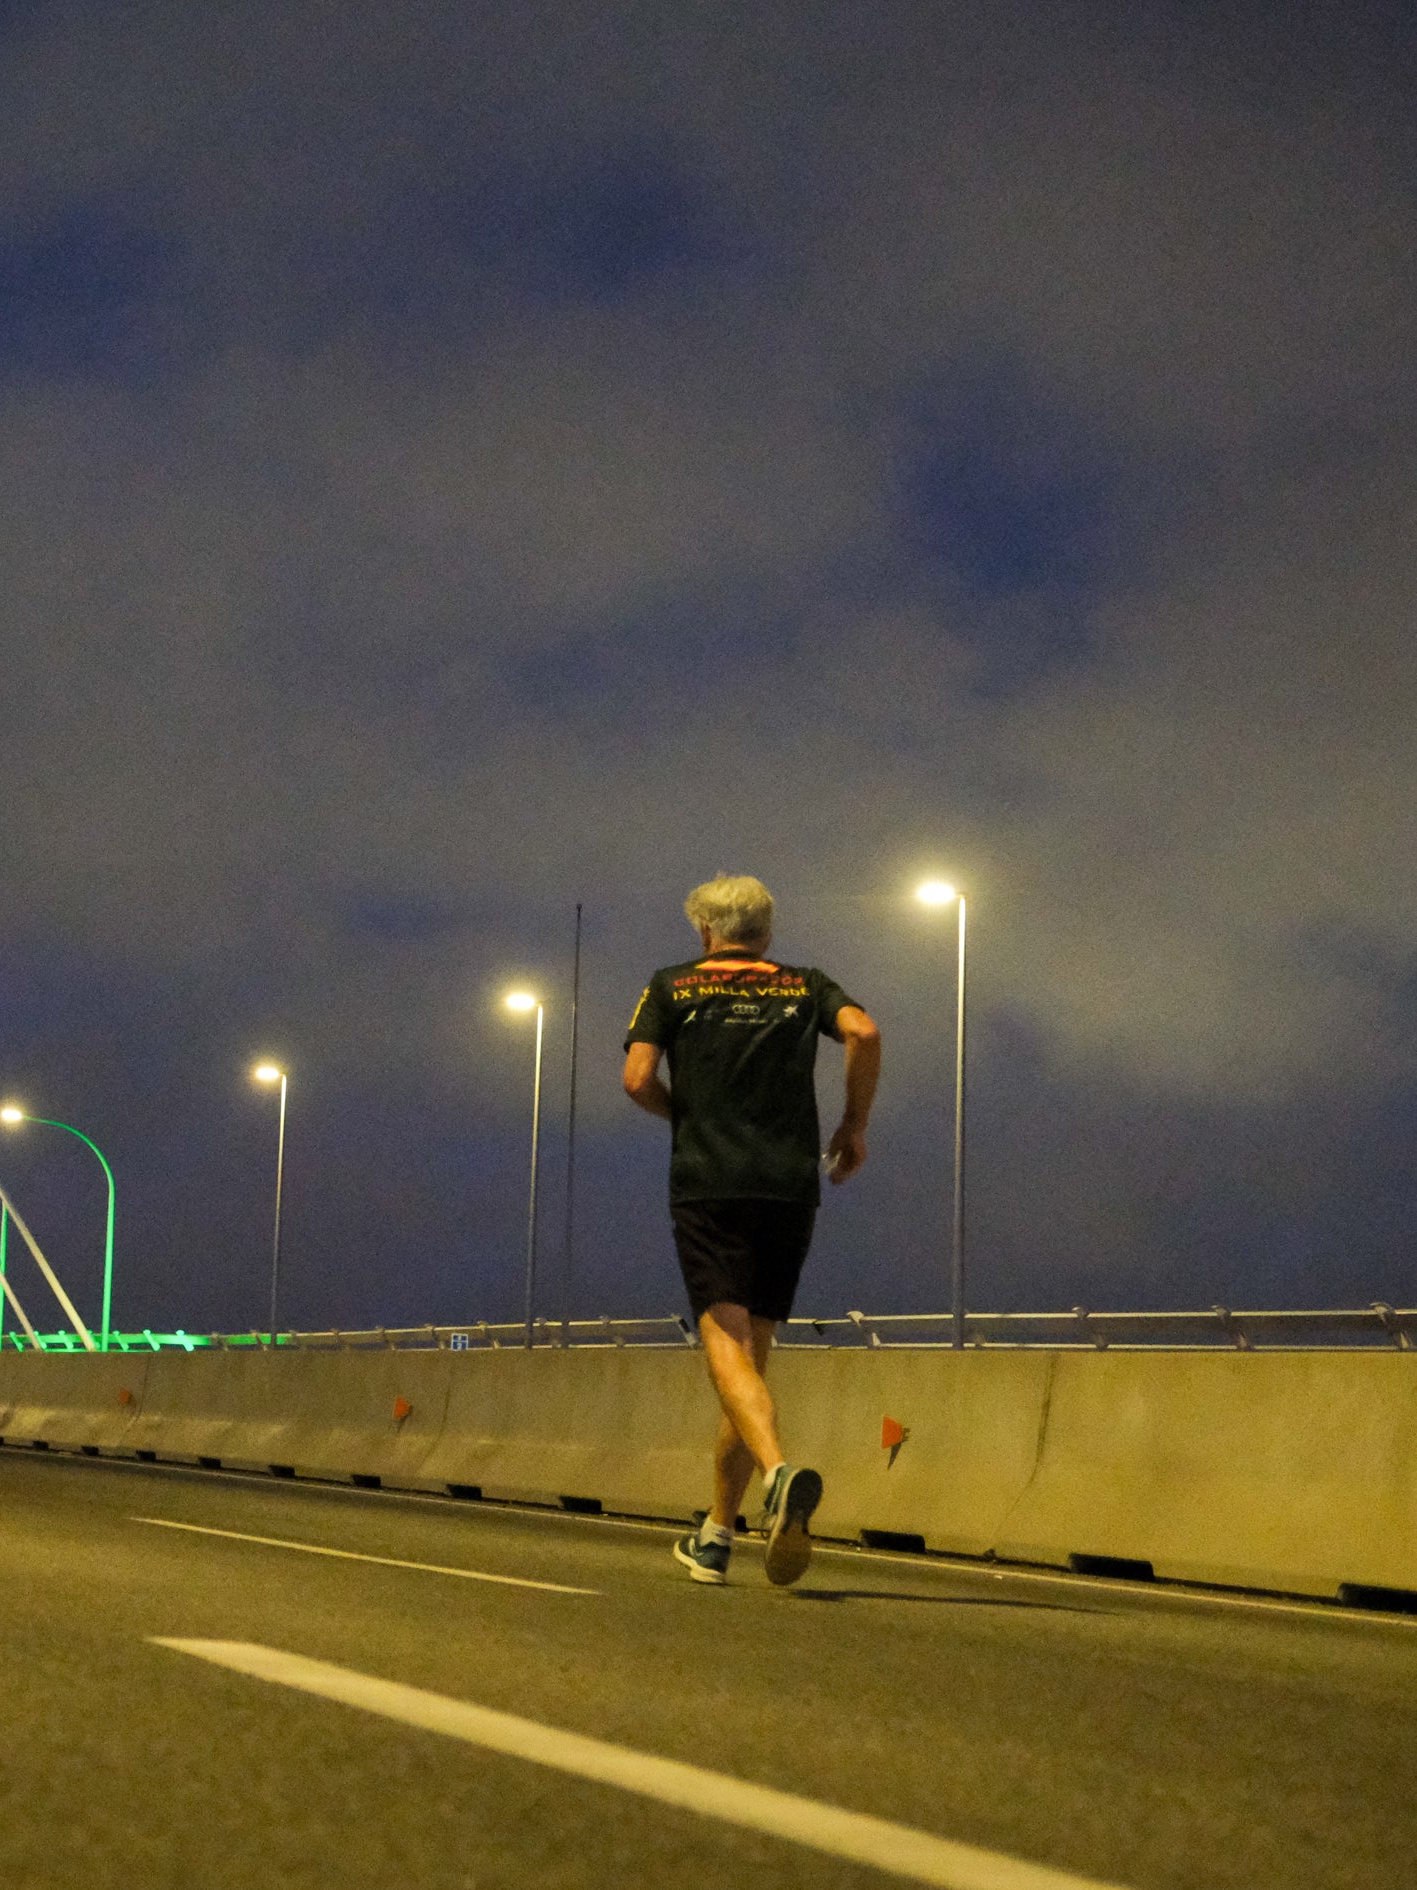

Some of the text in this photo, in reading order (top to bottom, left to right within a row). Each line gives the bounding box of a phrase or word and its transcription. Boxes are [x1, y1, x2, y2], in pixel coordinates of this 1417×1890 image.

[672, 986, 809, 1001] IX MILLA VERDE
